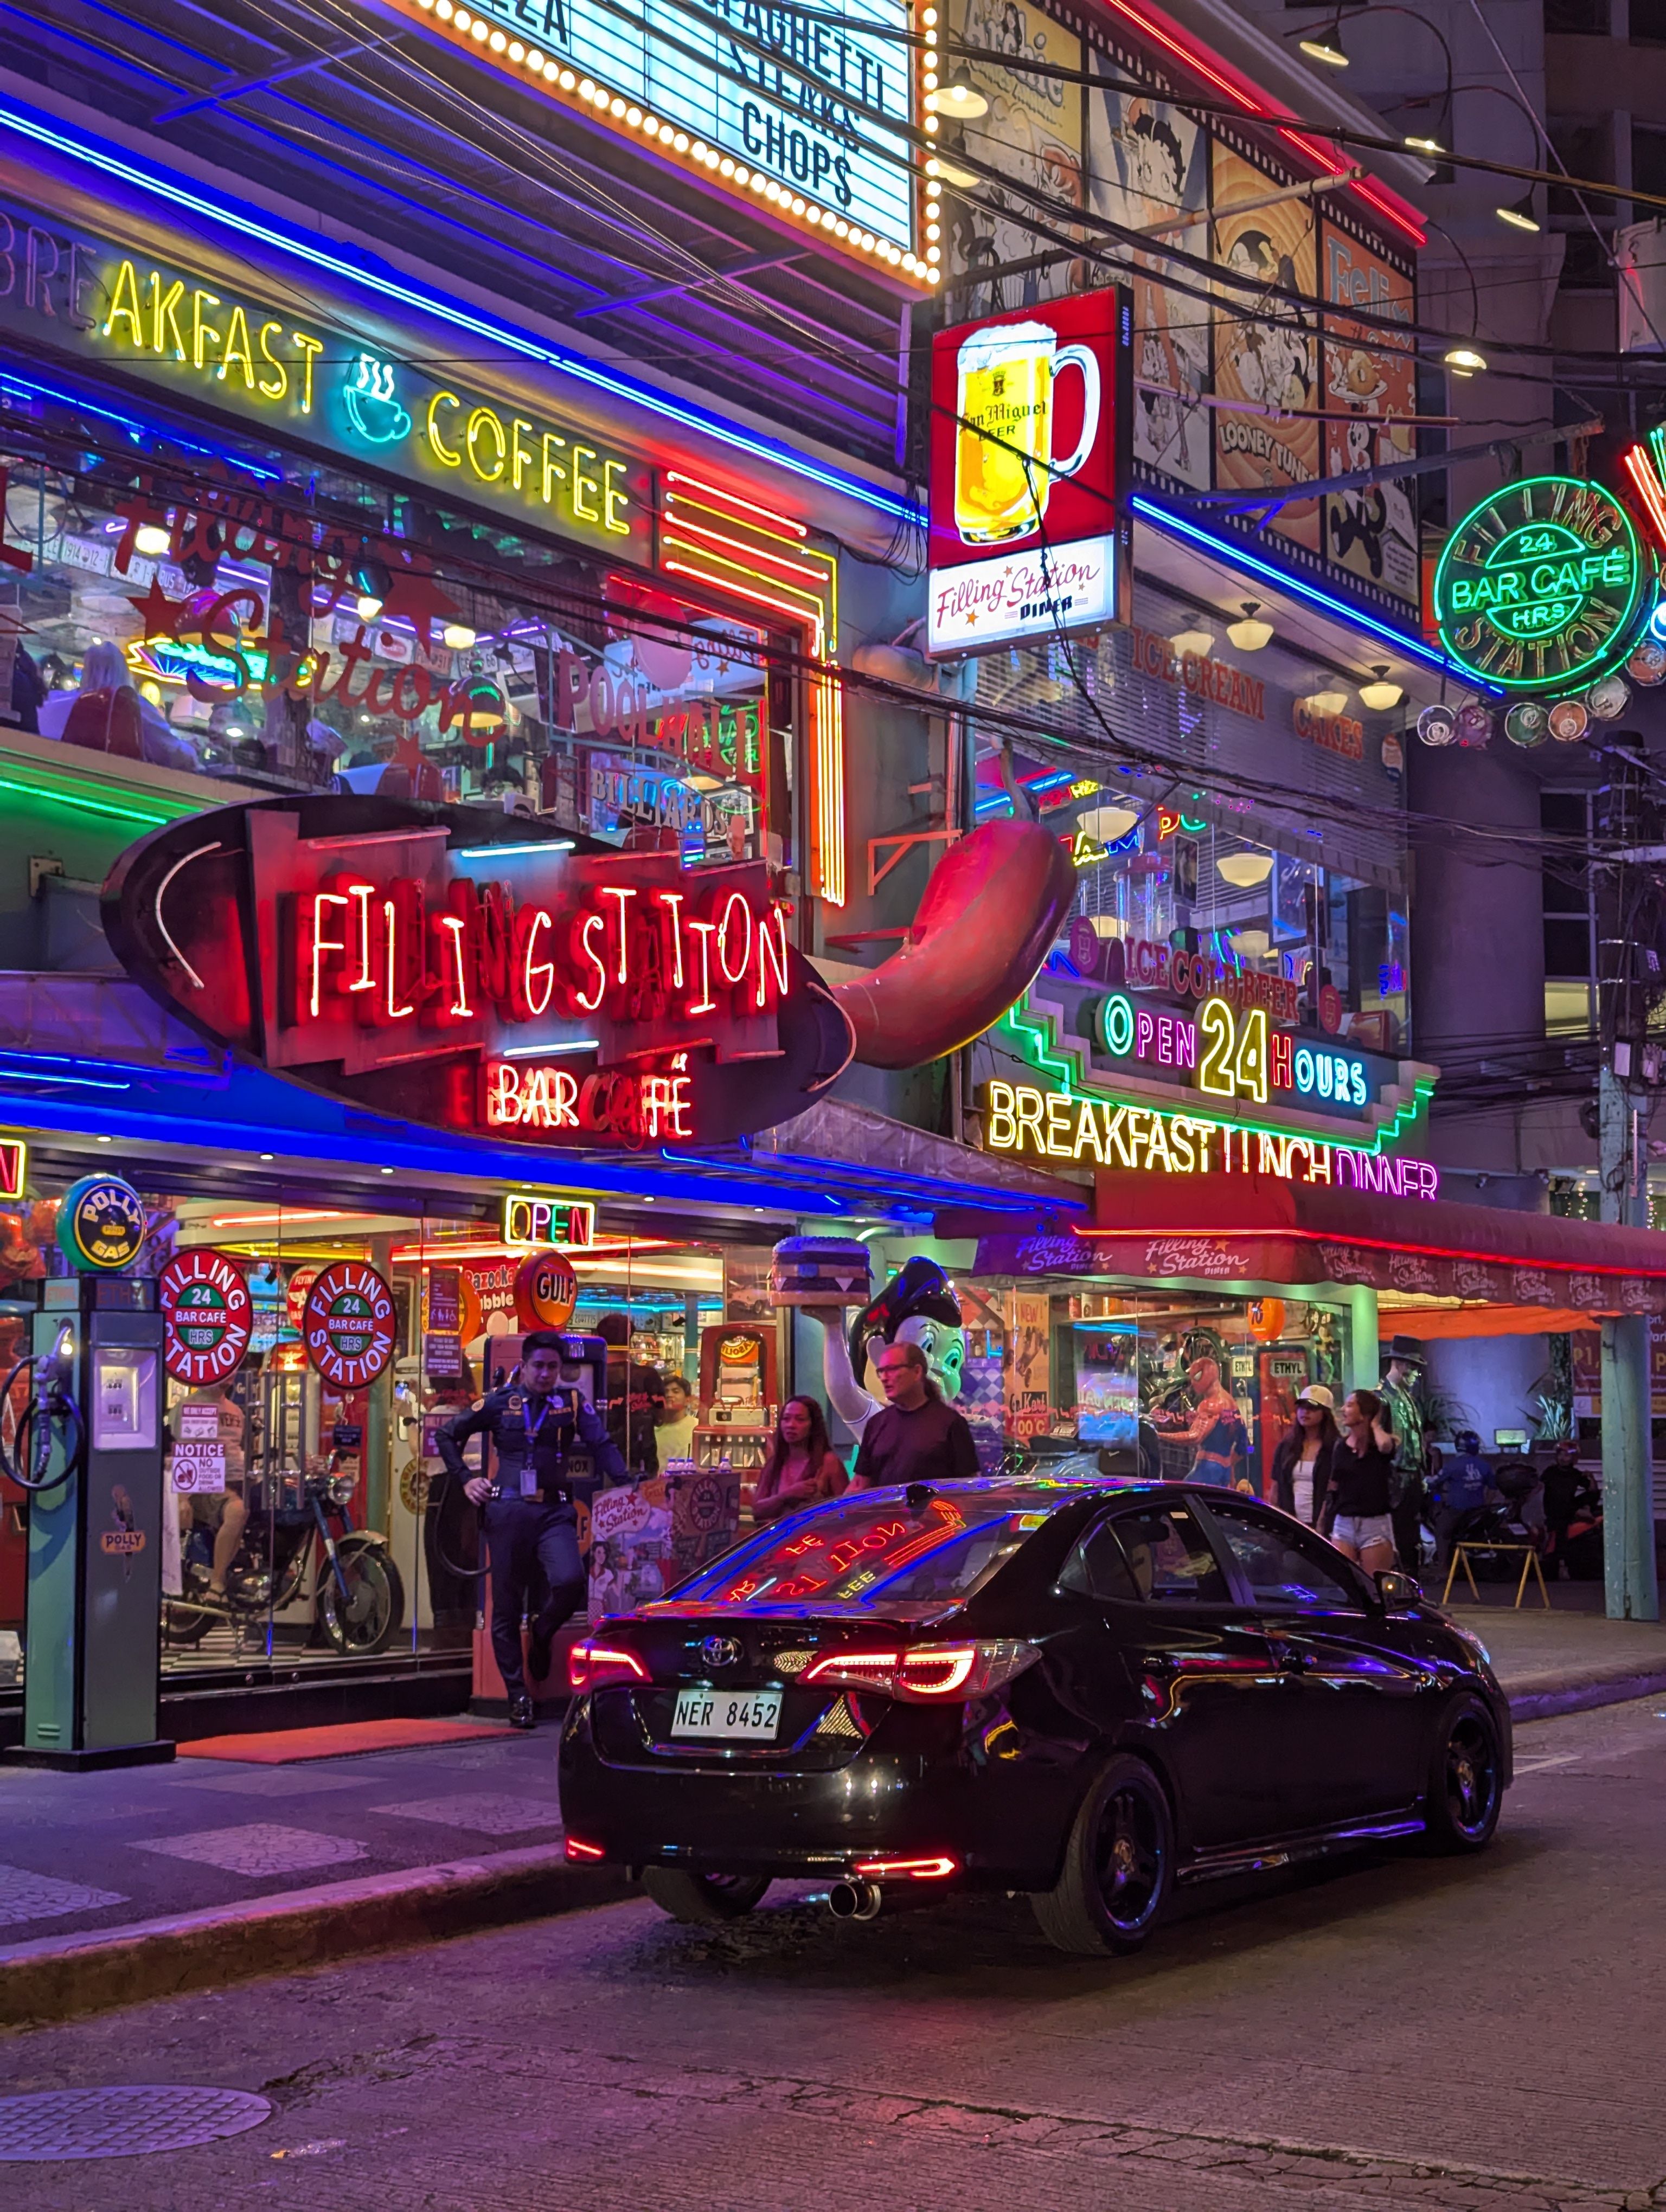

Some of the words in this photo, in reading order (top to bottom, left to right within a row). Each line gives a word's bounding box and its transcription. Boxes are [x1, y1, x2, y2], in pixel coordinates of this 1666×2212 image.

[743, 101, 853, 207] CHOPS
[985, 400, 1046, 428] Miguel
[1218, 421, 1275, 462] LOONEY
[428, 390, 630, 535] COFFEE
[1519, 533, 1553, 553] 24
[1452, 571, 1519, 613] BAR
[1531, 546, 1629, 595] CAFÉ
[937, 578, 1008, 629] Filling
[1006, 560, 1101, 608] Station
[1019, 595, 1073, 621] DINER
[1512, 605, 1566, 629] HRS
[1454, 596, 1620, 679] STATION
[1132, 627, 1177, 685] ICE
[1181, 650, 1266, 722] CREAM
[1292, 698, 1364, 761] CAKES
[591, 768, 728, 836] BILLIARDS
[1124, 936, 1169, 991] ICE
[1170, 949, 1238, 1005] COLD
[1241, 968, 1300, 1023] BEER
[1103, 993, 1196, 1069] OPEN
[1199, 997, 1269, 1104] 24
[1271, 1033, 1367, 1105] HOURS
[490, 1063, 581, 1128] BAR
[988, 1081, 1216, 1174] BREAKFAST
[1336, 1147, 1441, 1201] DINNER
[82, 1188, 140, 1226] POLLY
[510, 1202, 591, 1245] OPEN
[91, 1239, 131, 1259] GAS
[1015, 1234, 1079, 1259] Filling
[1027, 1248, 1113, 1270] Station
[1145, 1238, 1214, 1262] Filling
[1158, 1247, 1250, 1276] Station
[191, 1288, 212, 1306] 24
[310, 1266, 391, 1320] FILLING
[536, 1272, 574, 1306] GULF
[175, 1310, 197, 1323] BAR
[198, 1309, 227, 1324] CAFÉ
[342, 1297, 361, 1314] 24
[189, 1329, 214, 1345] HRS
[328, 1319, 348, 1330] BAR
[349, 1317, 374, 1332] CAFÉ
[310, 1328, 392, 1383] STATION
[340, 1335, 362, 1351] HRS
[1274, 1362, 1302, 1374] ETHYL
[175, 1443, 224, 1456] NOTICE
[198, 1458, 214, 1468] NO
[605, 1506, 648, 1533] Station
[105, 1533, 142, 1547] POLLY
[676, 1701, 714, 1728] NER
[726, 1701, 778, 1729] 8452
